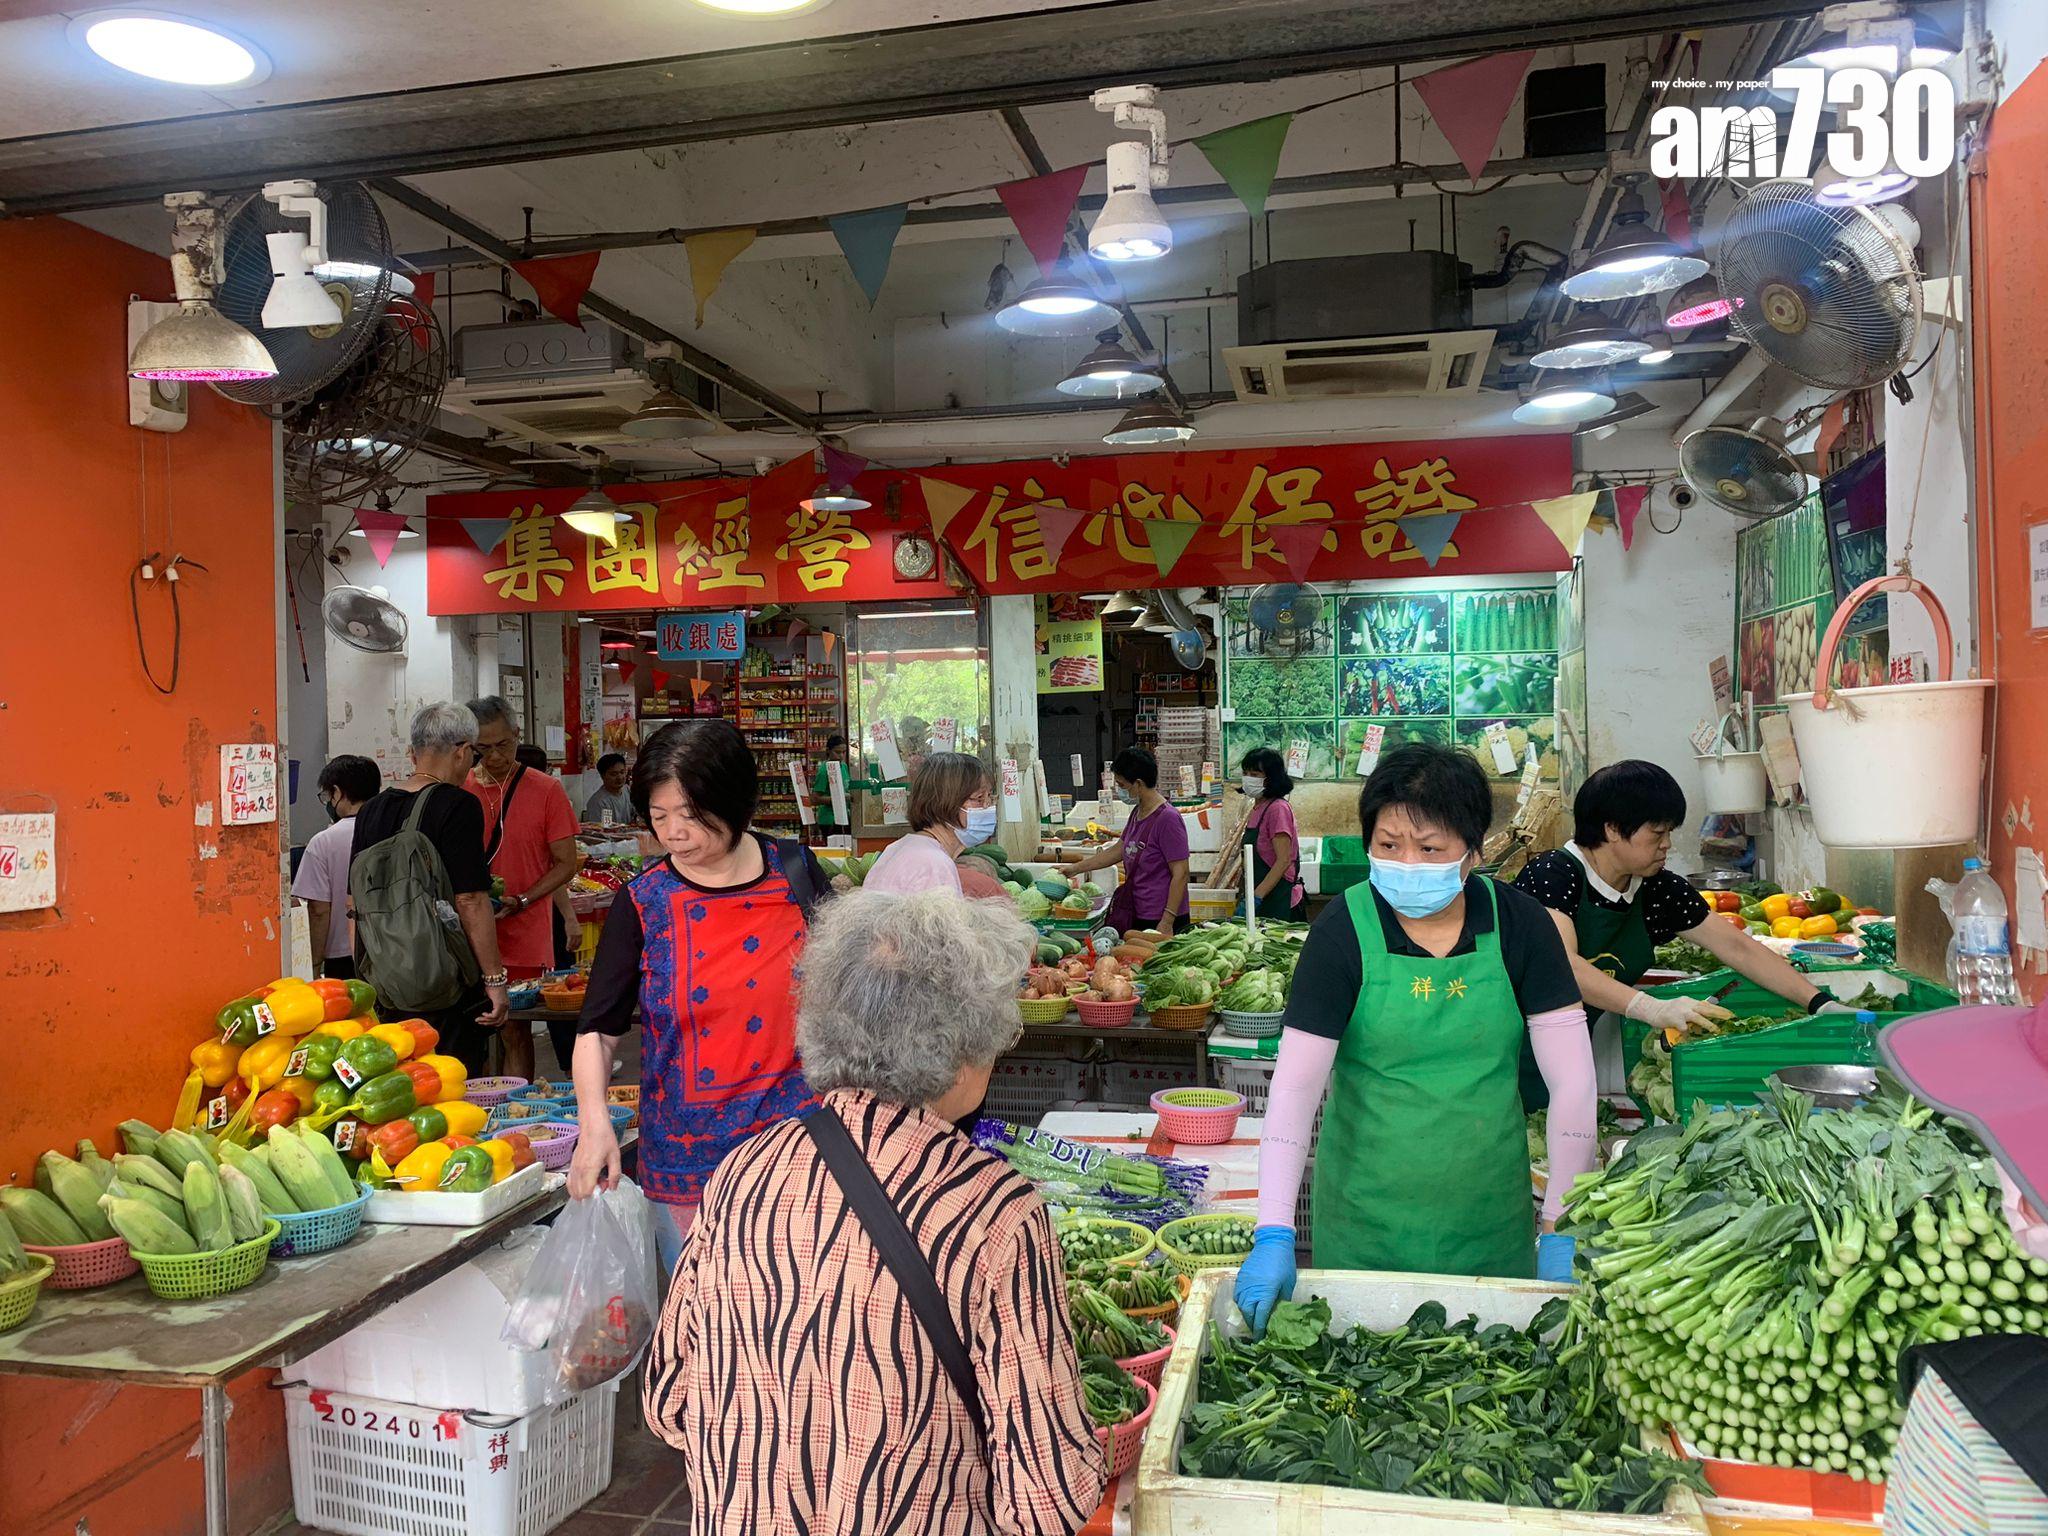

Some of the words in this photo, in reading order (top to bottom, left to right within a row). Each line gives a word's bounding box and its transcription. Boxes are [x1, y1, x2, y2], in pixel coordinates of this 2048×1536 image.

[482, 496, 871, 602] 集團經營
[964, 457, 1478, 583] 信心保證
[661, 622, 738, 652] 收銀處
[1053, 632, 1094, 643] 精挑細選
[231, 746, 272, 760] 三色椒
[1409, 975, 1468, 1003] 祥兴
[1561, 1131, 1597, 1139] AQU
[487, 1430, 509, 1474] 祥興
